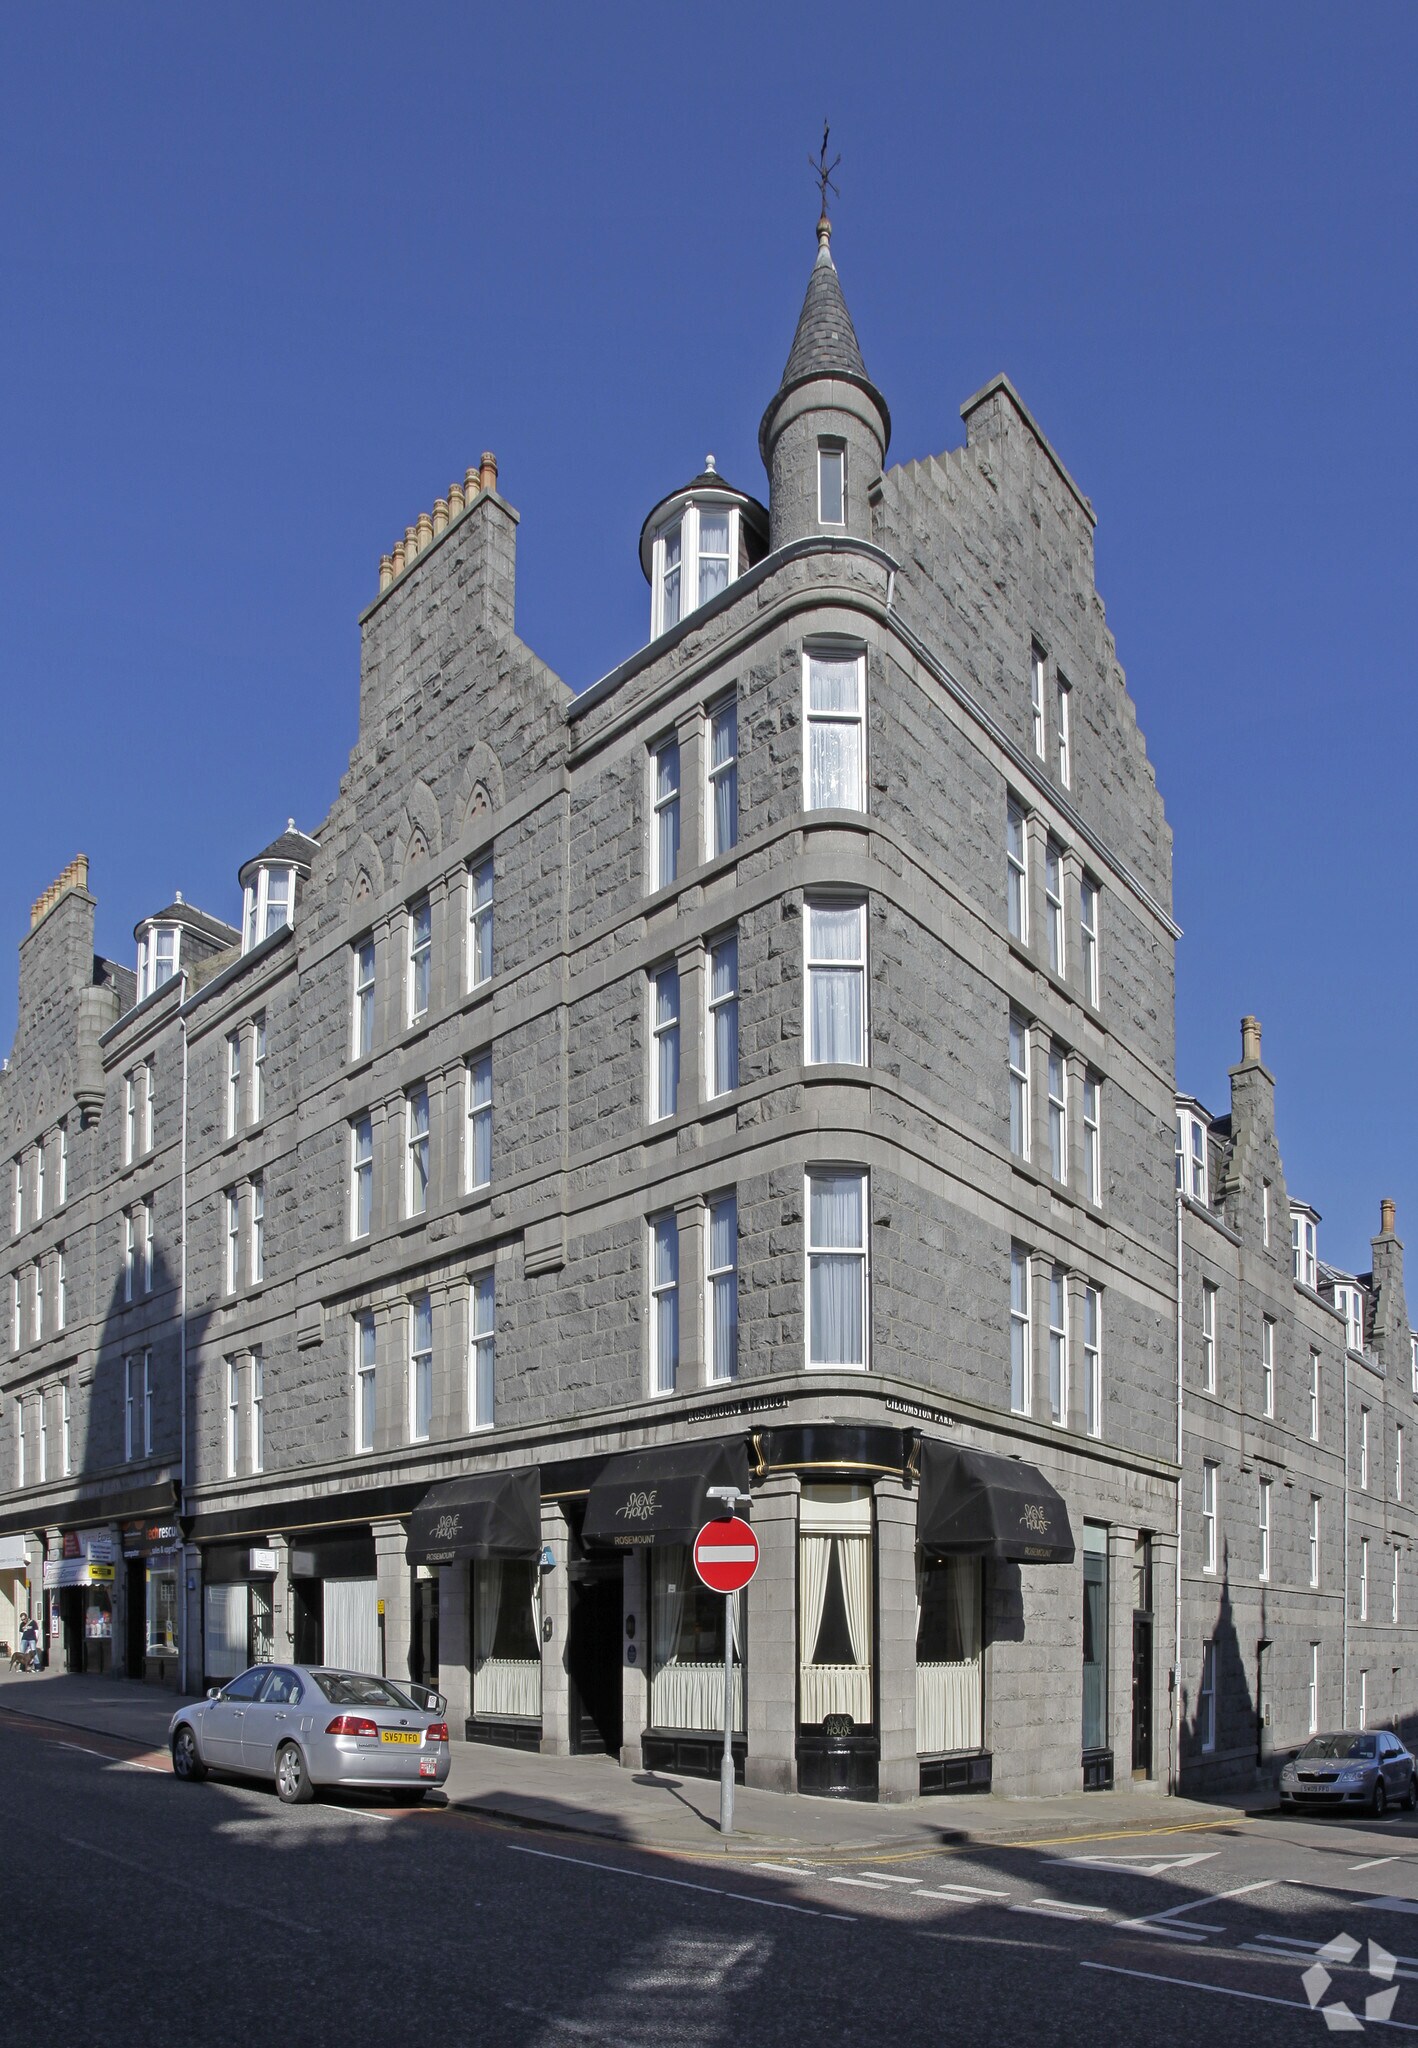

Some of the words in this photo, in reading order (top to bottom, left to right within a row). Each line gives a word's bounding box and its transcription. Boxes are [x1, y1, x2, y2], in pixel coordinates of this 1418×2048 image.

[688, 1401, 743, 1422] ROSEMOUNT
[747, 1395, 788, 1411] VIADUCT
[886, 1398, 932, 1419] GILCOMSTON
[627, 1490, 657, 1507] SKENE
[616, 1505, 662, 1520] HOUSE
[430, 1526, 463, 1540] HOUSE
[614, 1534, 656, 1545] ROSEMOUNT
[426, 1550, 456, 1561] ROSEMOUNT
[384, 1732, 403, 1742] SV57
[404, 1734, 418, 1743] TFO
